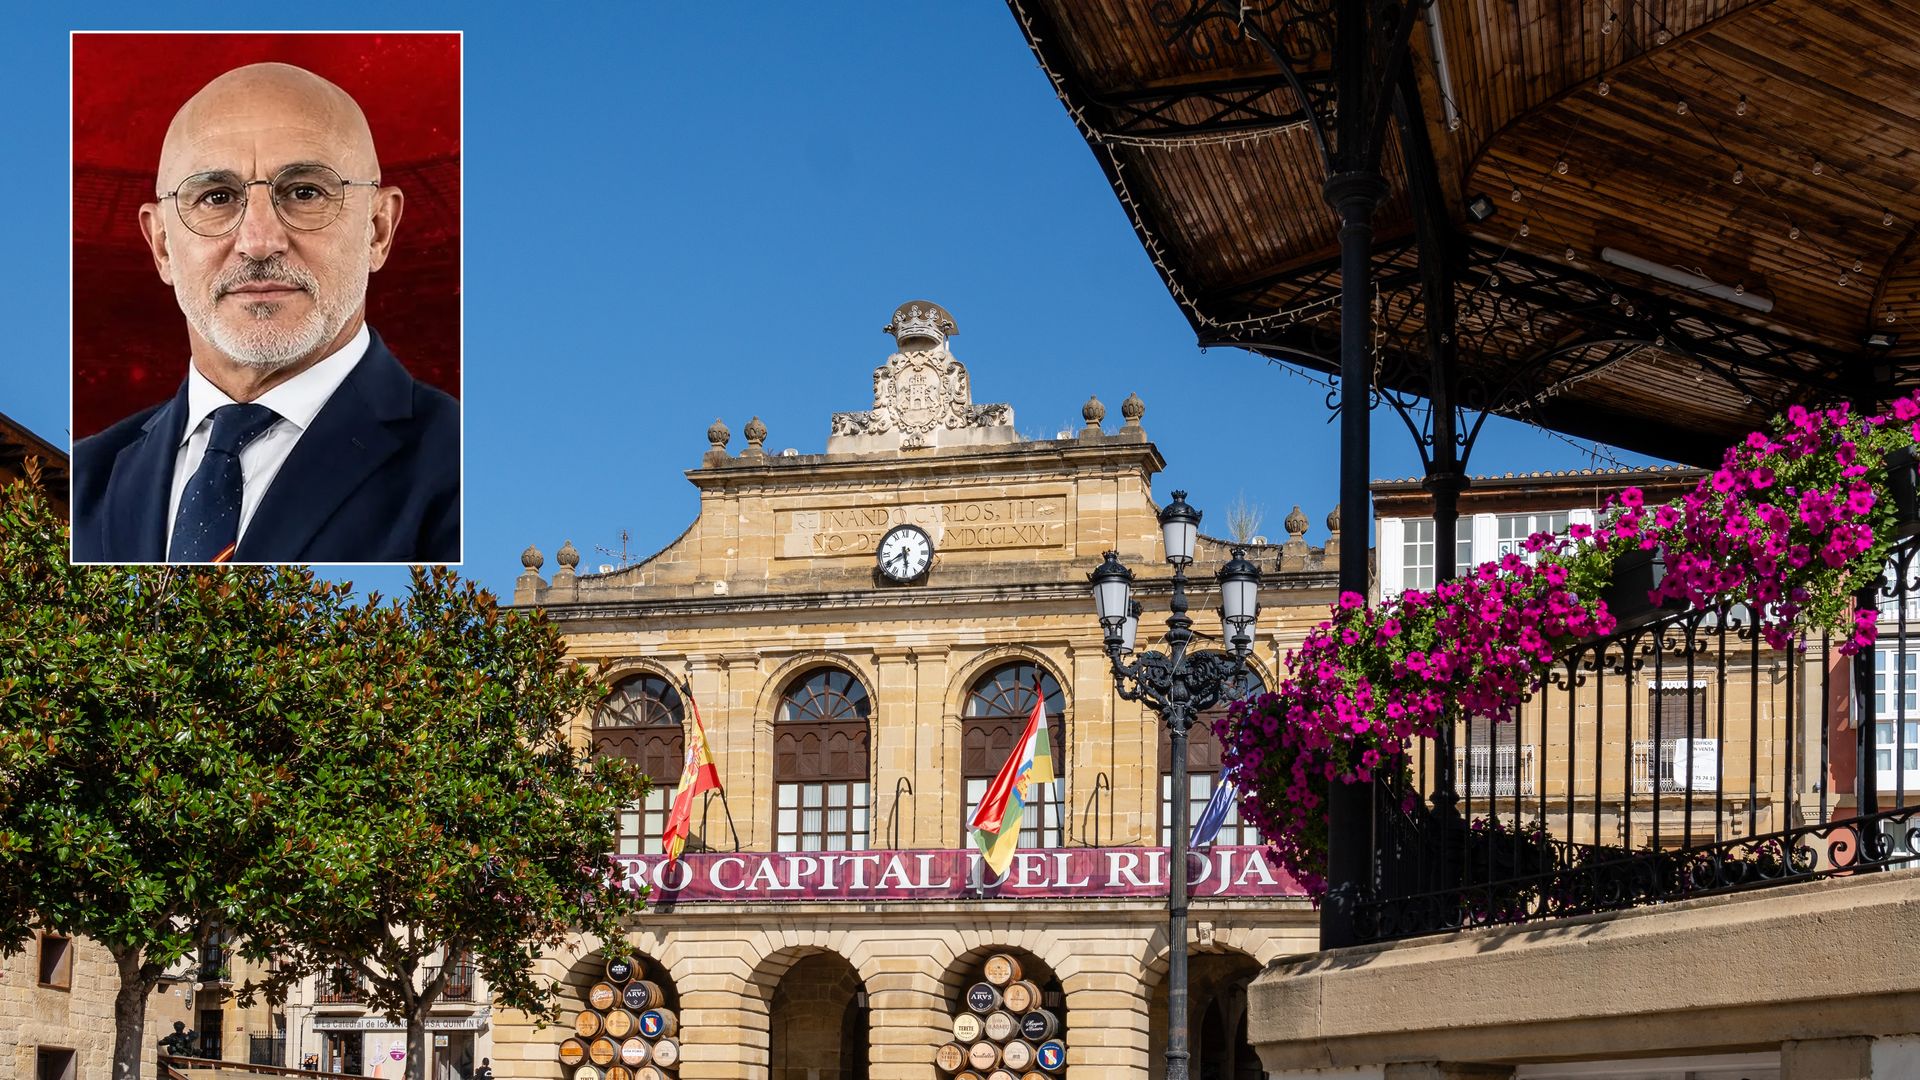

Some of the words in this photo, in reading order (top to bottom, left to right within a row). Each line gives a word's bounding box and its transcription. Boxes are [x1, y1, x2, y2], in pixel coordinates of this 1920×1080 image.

[709, 854, 951, 892] CAPITAL
[966, 852, 1089, 889] DEL
[1105, 849, 1279, 895] RIOJA
[321, 1020, 331, 1029] La
[333, 1020, 364, 1029] Catedral
[365, 1020, 375, 1028] de
[377, 1019, 388, 1028] los
[425, 1019, 441, 1028] ASA
